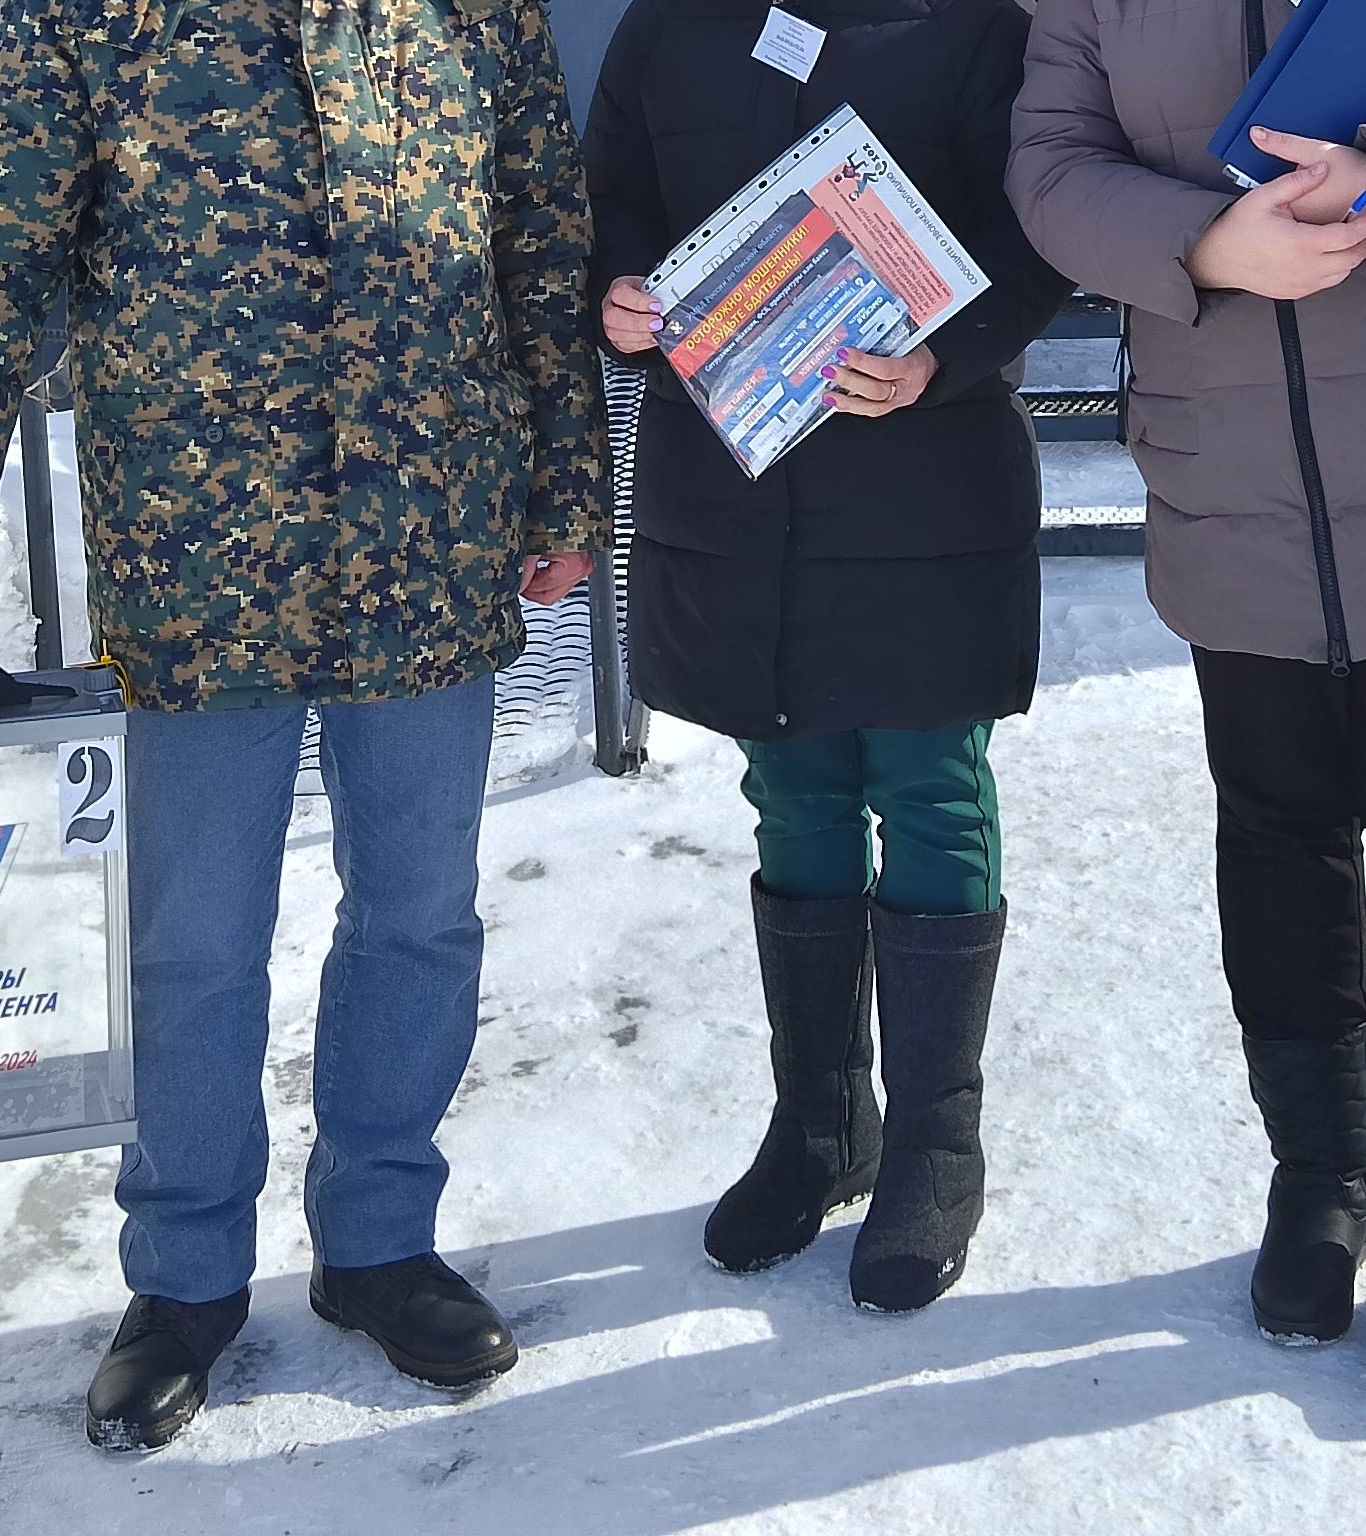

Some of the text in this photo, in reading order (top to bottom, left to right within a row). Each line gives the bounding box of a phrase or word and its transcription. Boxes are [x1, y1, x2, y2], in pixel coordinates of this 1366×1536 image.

[703, 278, 728, 303] России
[732, 245, 759, 273] Омской
[755, 221, 784, 250] области
[861, 141, 979, 286] СООБЩИТЕ О ЗВОНКЕ В ПОЛИЦИЮ 102
[683, 287, 747, 351] ОСТОРОЖНО!
[741, 222, 810, 293] МОШЕННИКИ!
[710, 308, 748, 346] БУДЬТЕ
[742, 249, 805, 313] БДИТЕЛЬНЫ!
[65, 745, 116, 846] 2
